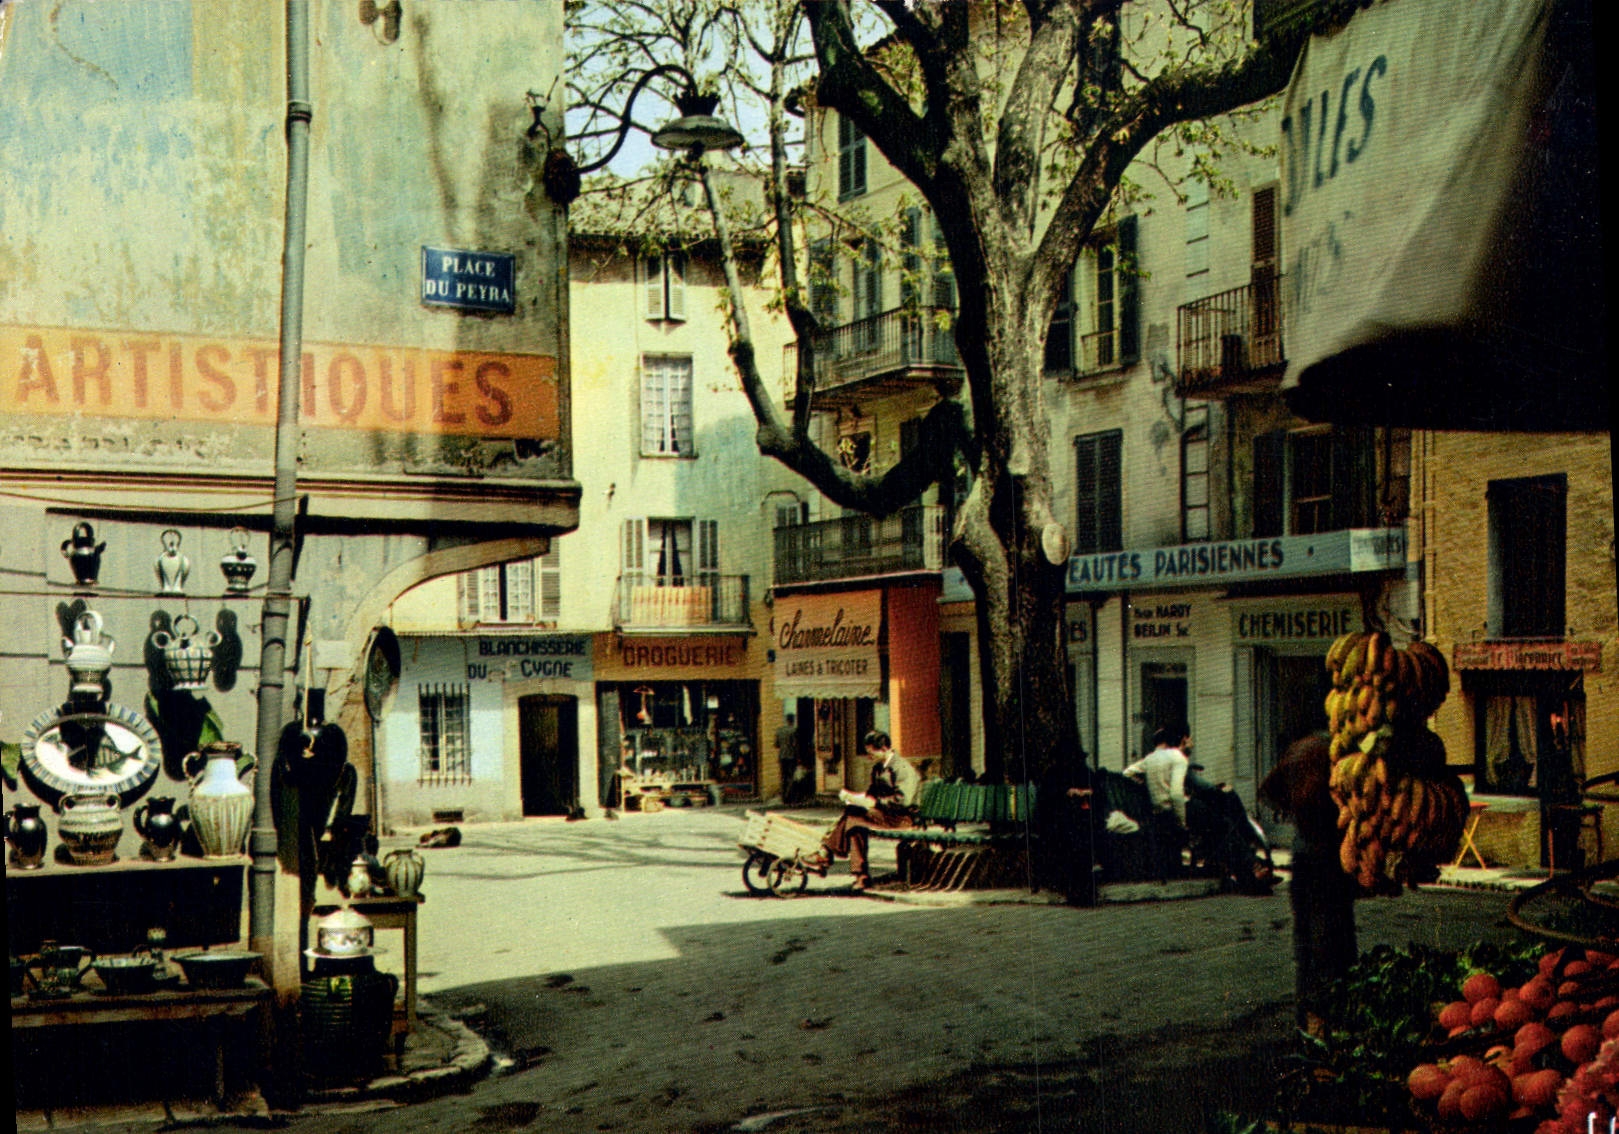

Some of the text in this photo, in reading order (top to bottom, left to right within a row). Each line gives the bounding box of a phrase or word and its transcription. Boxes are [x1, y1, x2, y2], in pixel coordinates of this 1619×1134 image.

[442, 255, 496, 277] PLACE
[426, 279, 510, 302] DU PEYRA
[15, 334, 513, 427] ARTISTIQUES
[1154, 540, 1284, 578] PARISIENNES
[1239, 609, 1351, 636] CHEMISERIE
[479, 640, 586, 656] BLANCHISSERIE
[623, 645, 737, 667] DROGUERIE
[468, 663, 487, 679] DU
[826, 659, 868, 675] TRICOTER
